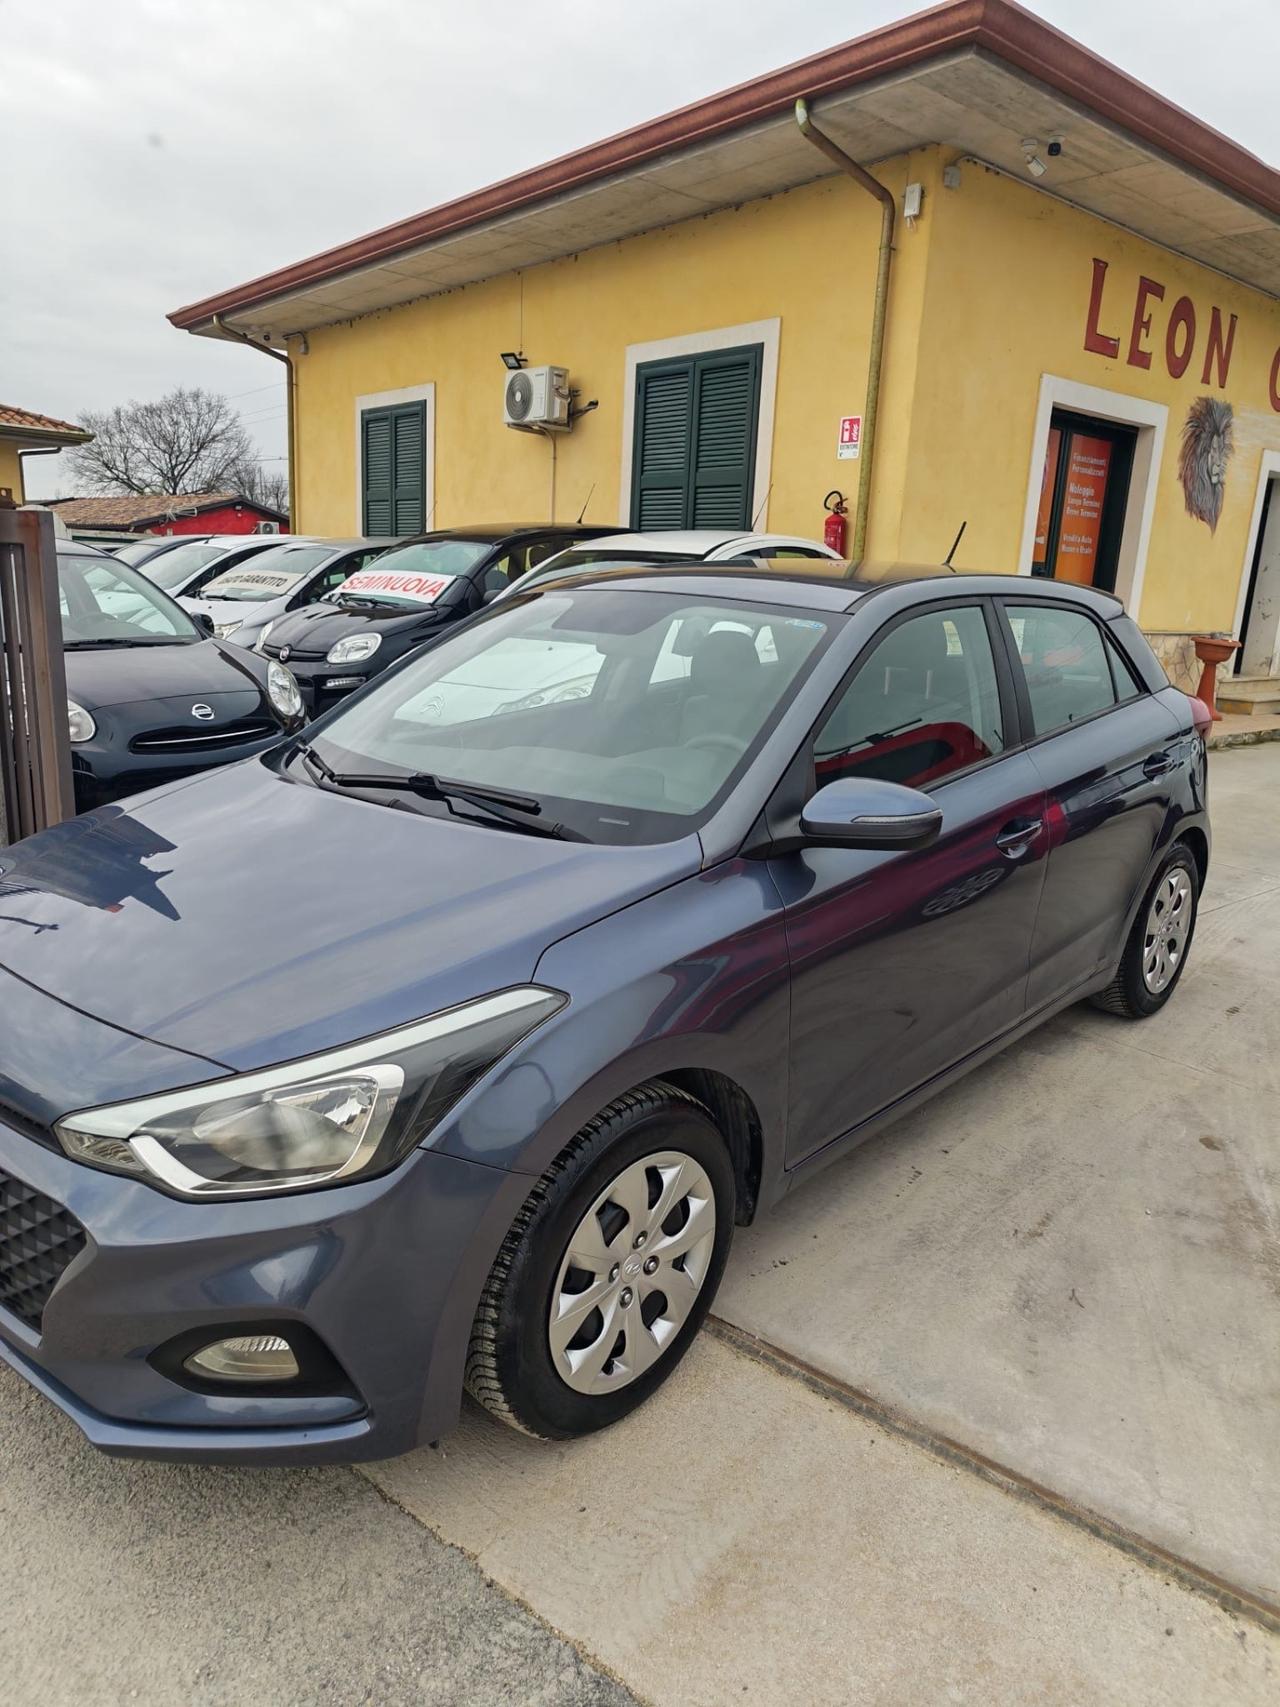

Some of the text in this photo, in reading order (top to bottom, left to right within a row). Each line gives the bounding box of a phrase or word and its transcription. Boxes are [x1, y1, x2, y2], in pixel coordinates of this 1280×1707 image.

[1084, 257, 1238, 388] LEON
[1070, 483, 1095, 496] Noleggio
[341, 574, 446, 597] SEMINUOVA
